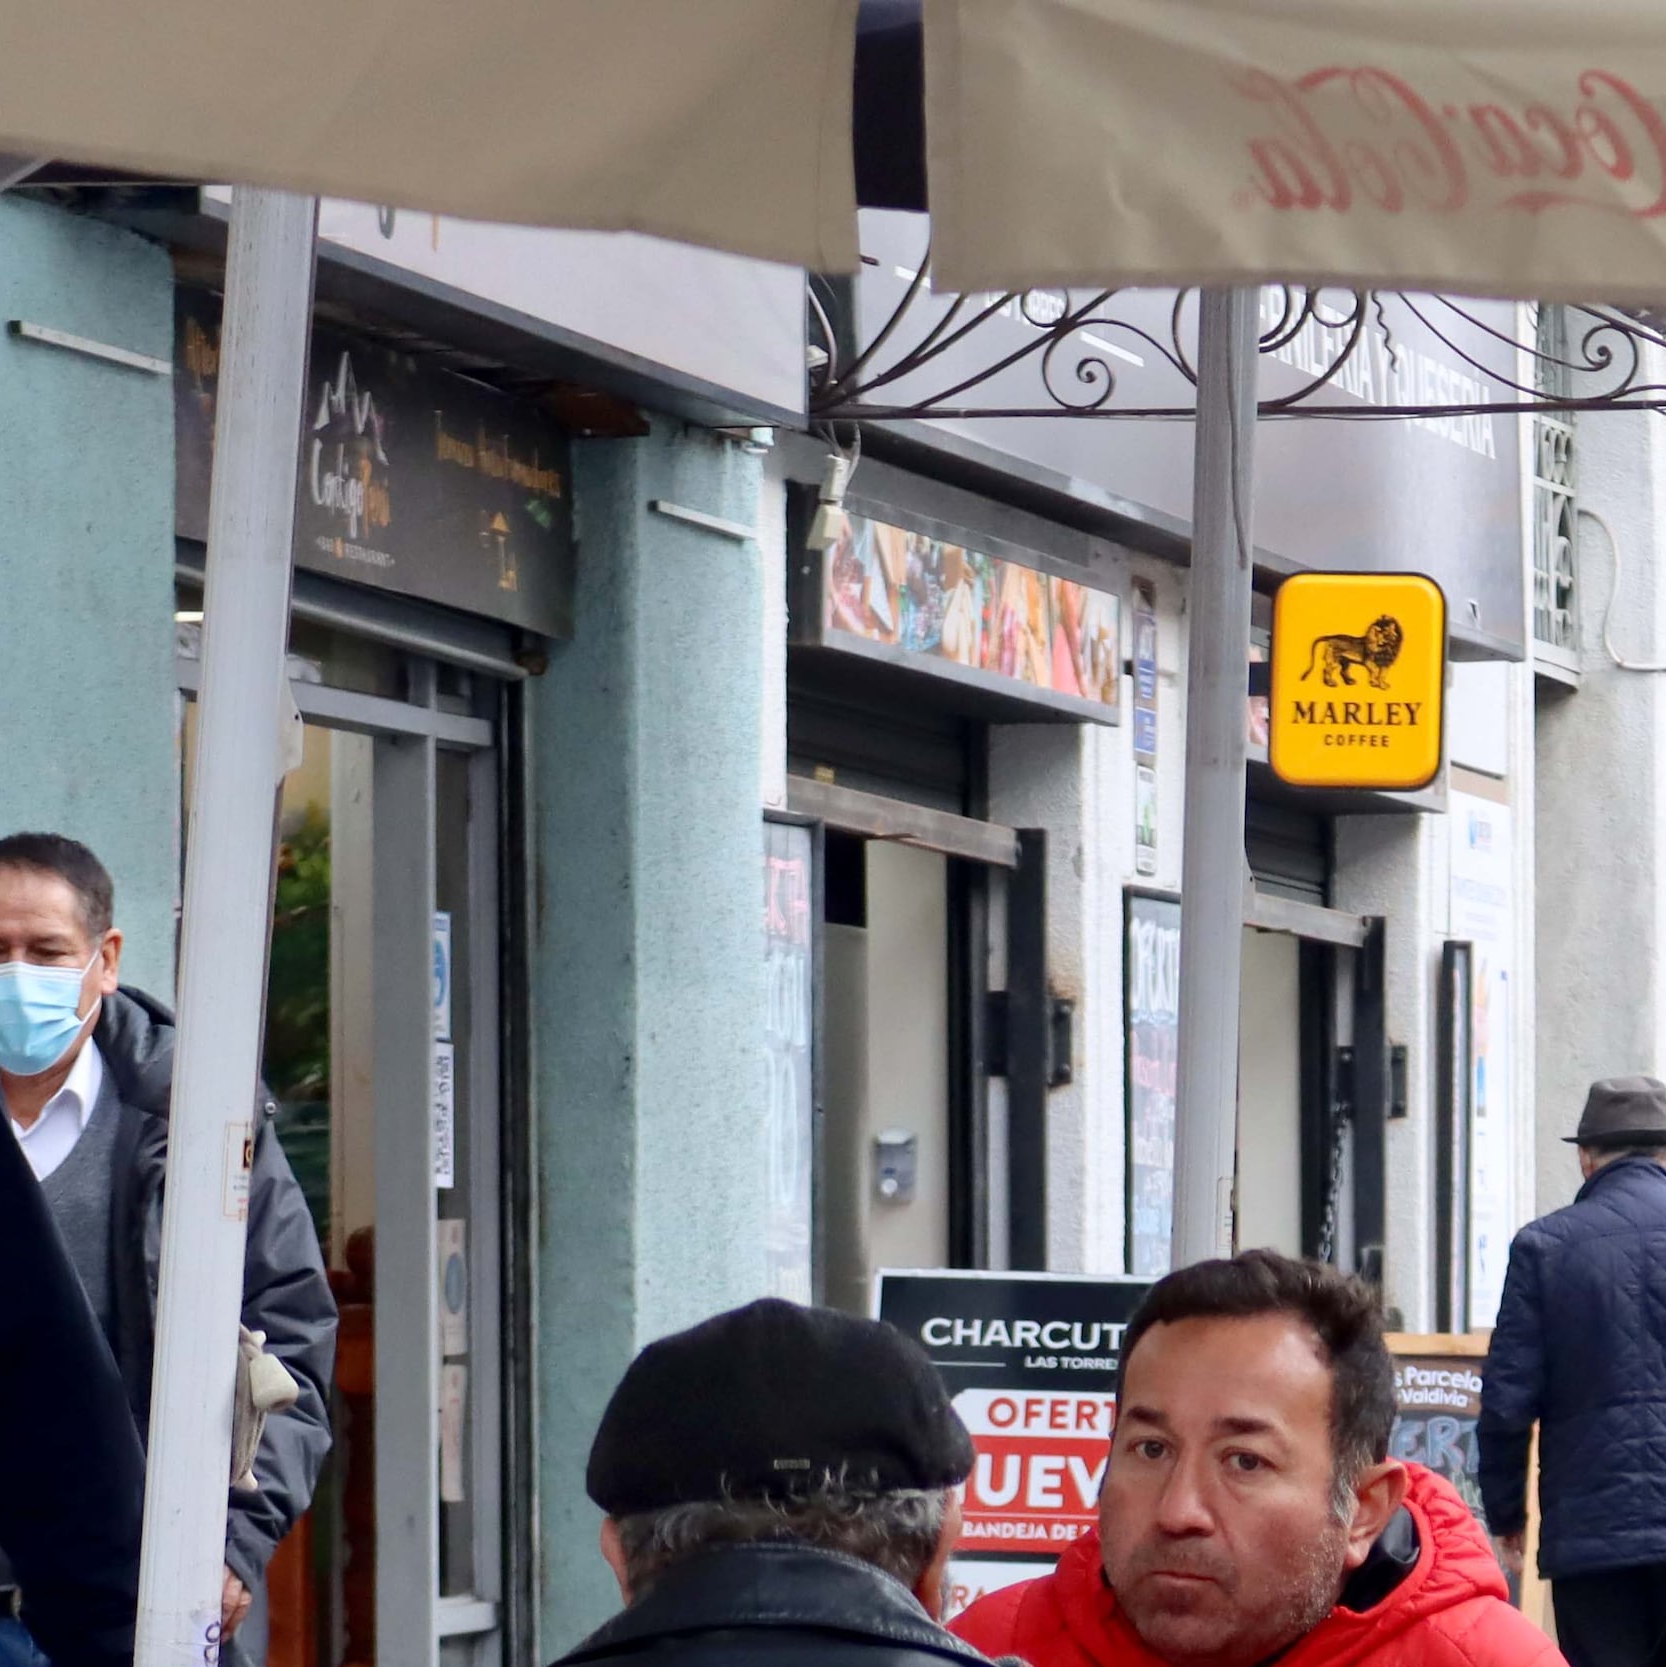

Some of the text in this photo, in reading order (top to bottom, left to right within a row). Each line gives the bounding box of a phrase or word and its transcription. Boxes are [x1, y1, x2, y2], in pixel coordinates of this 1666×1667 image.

[1291, 700, 1422, 726] MARLEY
[1323, 733, 1390, 748] COFFEE
[921, 1317, 1128, 1351] CHARCUT
[1025, 1355, 1119, 1371] LAS TORRE
[1404, 1366, 1483, 1393] Parcela
[987, 1397, 1117, 1431] OFERT
[953, 1453, 1109, 1509] UEV
[962, 1521, 1047, 1540] BANDEJA
[1051, 1524, 1078, 1541] DE
